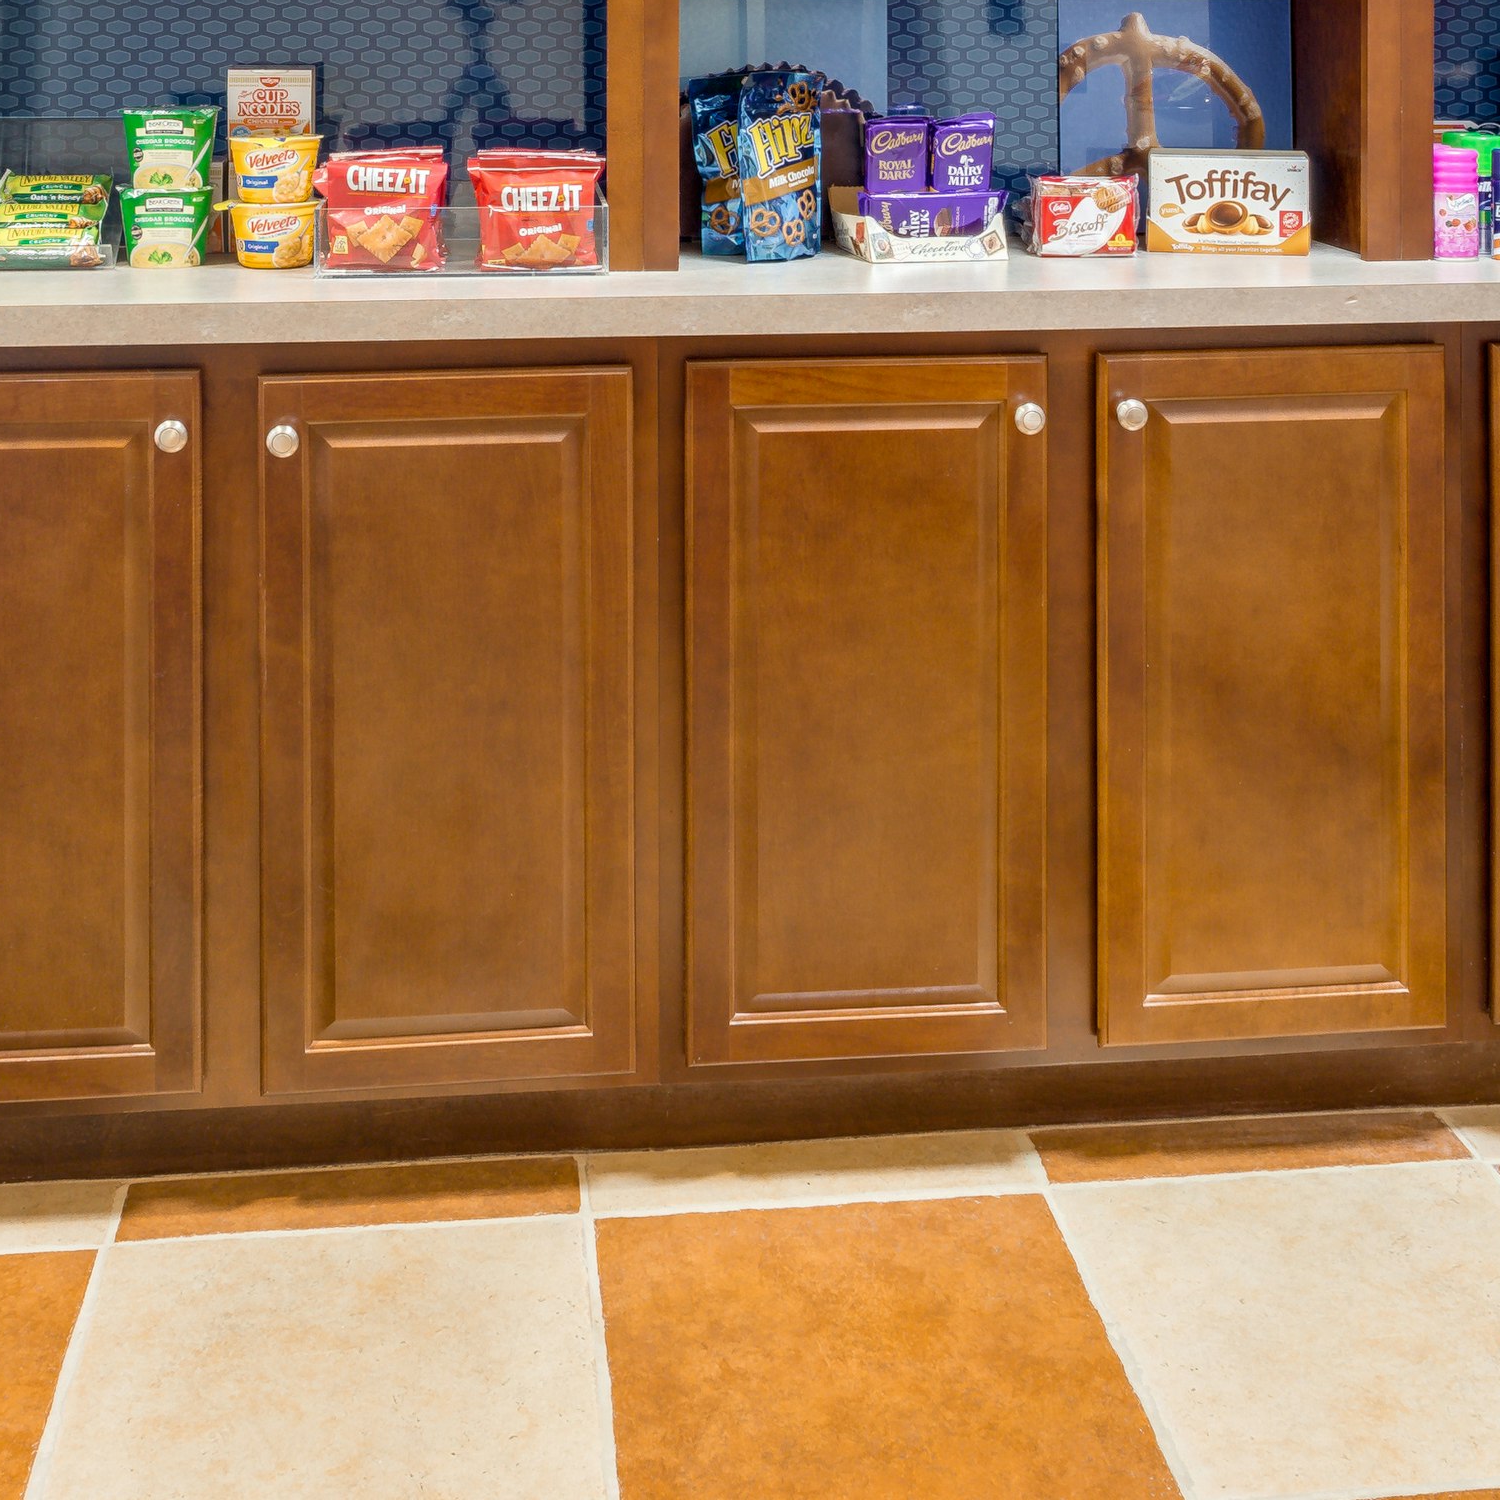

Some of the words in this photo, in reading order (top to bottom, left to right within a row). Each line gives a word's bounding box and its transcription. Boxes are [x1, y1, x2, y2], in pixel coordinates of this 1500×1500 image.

[252, 88, 289, 104] CUP
[237, 101, 301, 118] NOODLES
[135, 137, 163, 146] CHEDDAR
[164, 137, 196, 146] BROCCOLI
[748, 112, 817, 179] Flipz
[870, 130, 925, 155] Cadbury
[941, 132, 994, 156] Cadbury
[248, 149, 297, 169] Velveeta
[877, 158, 915, 171] ROYAL
[878, 169, 916, 181] DARK
[947, 164, 984, 177] DAIRY
[245, 178, 269, 186] Original
[768, 174, 787, 190] Milk
[947, 175, 984, 187] MILK
[1164, 168, 1291, 212] Toffifay
[30, 194, 48, 202] Oats
[57, 194, 82, 203] Honey
[6, 204, 41, 214] NATURE
[41, 204, 78, 215] VALLEY
[134, 215, 163, 224] CHEDDAR
[164, 215, 195, 224] BROCCOLI
[250, 216, 299, 234] Velveeta
[11, 228, 43, 238] NATURE
[43, 228, 78, 239] VALLEY
[1047, 213, 1109, 242] Biscoff
[246, 243, 270, 251] Original
